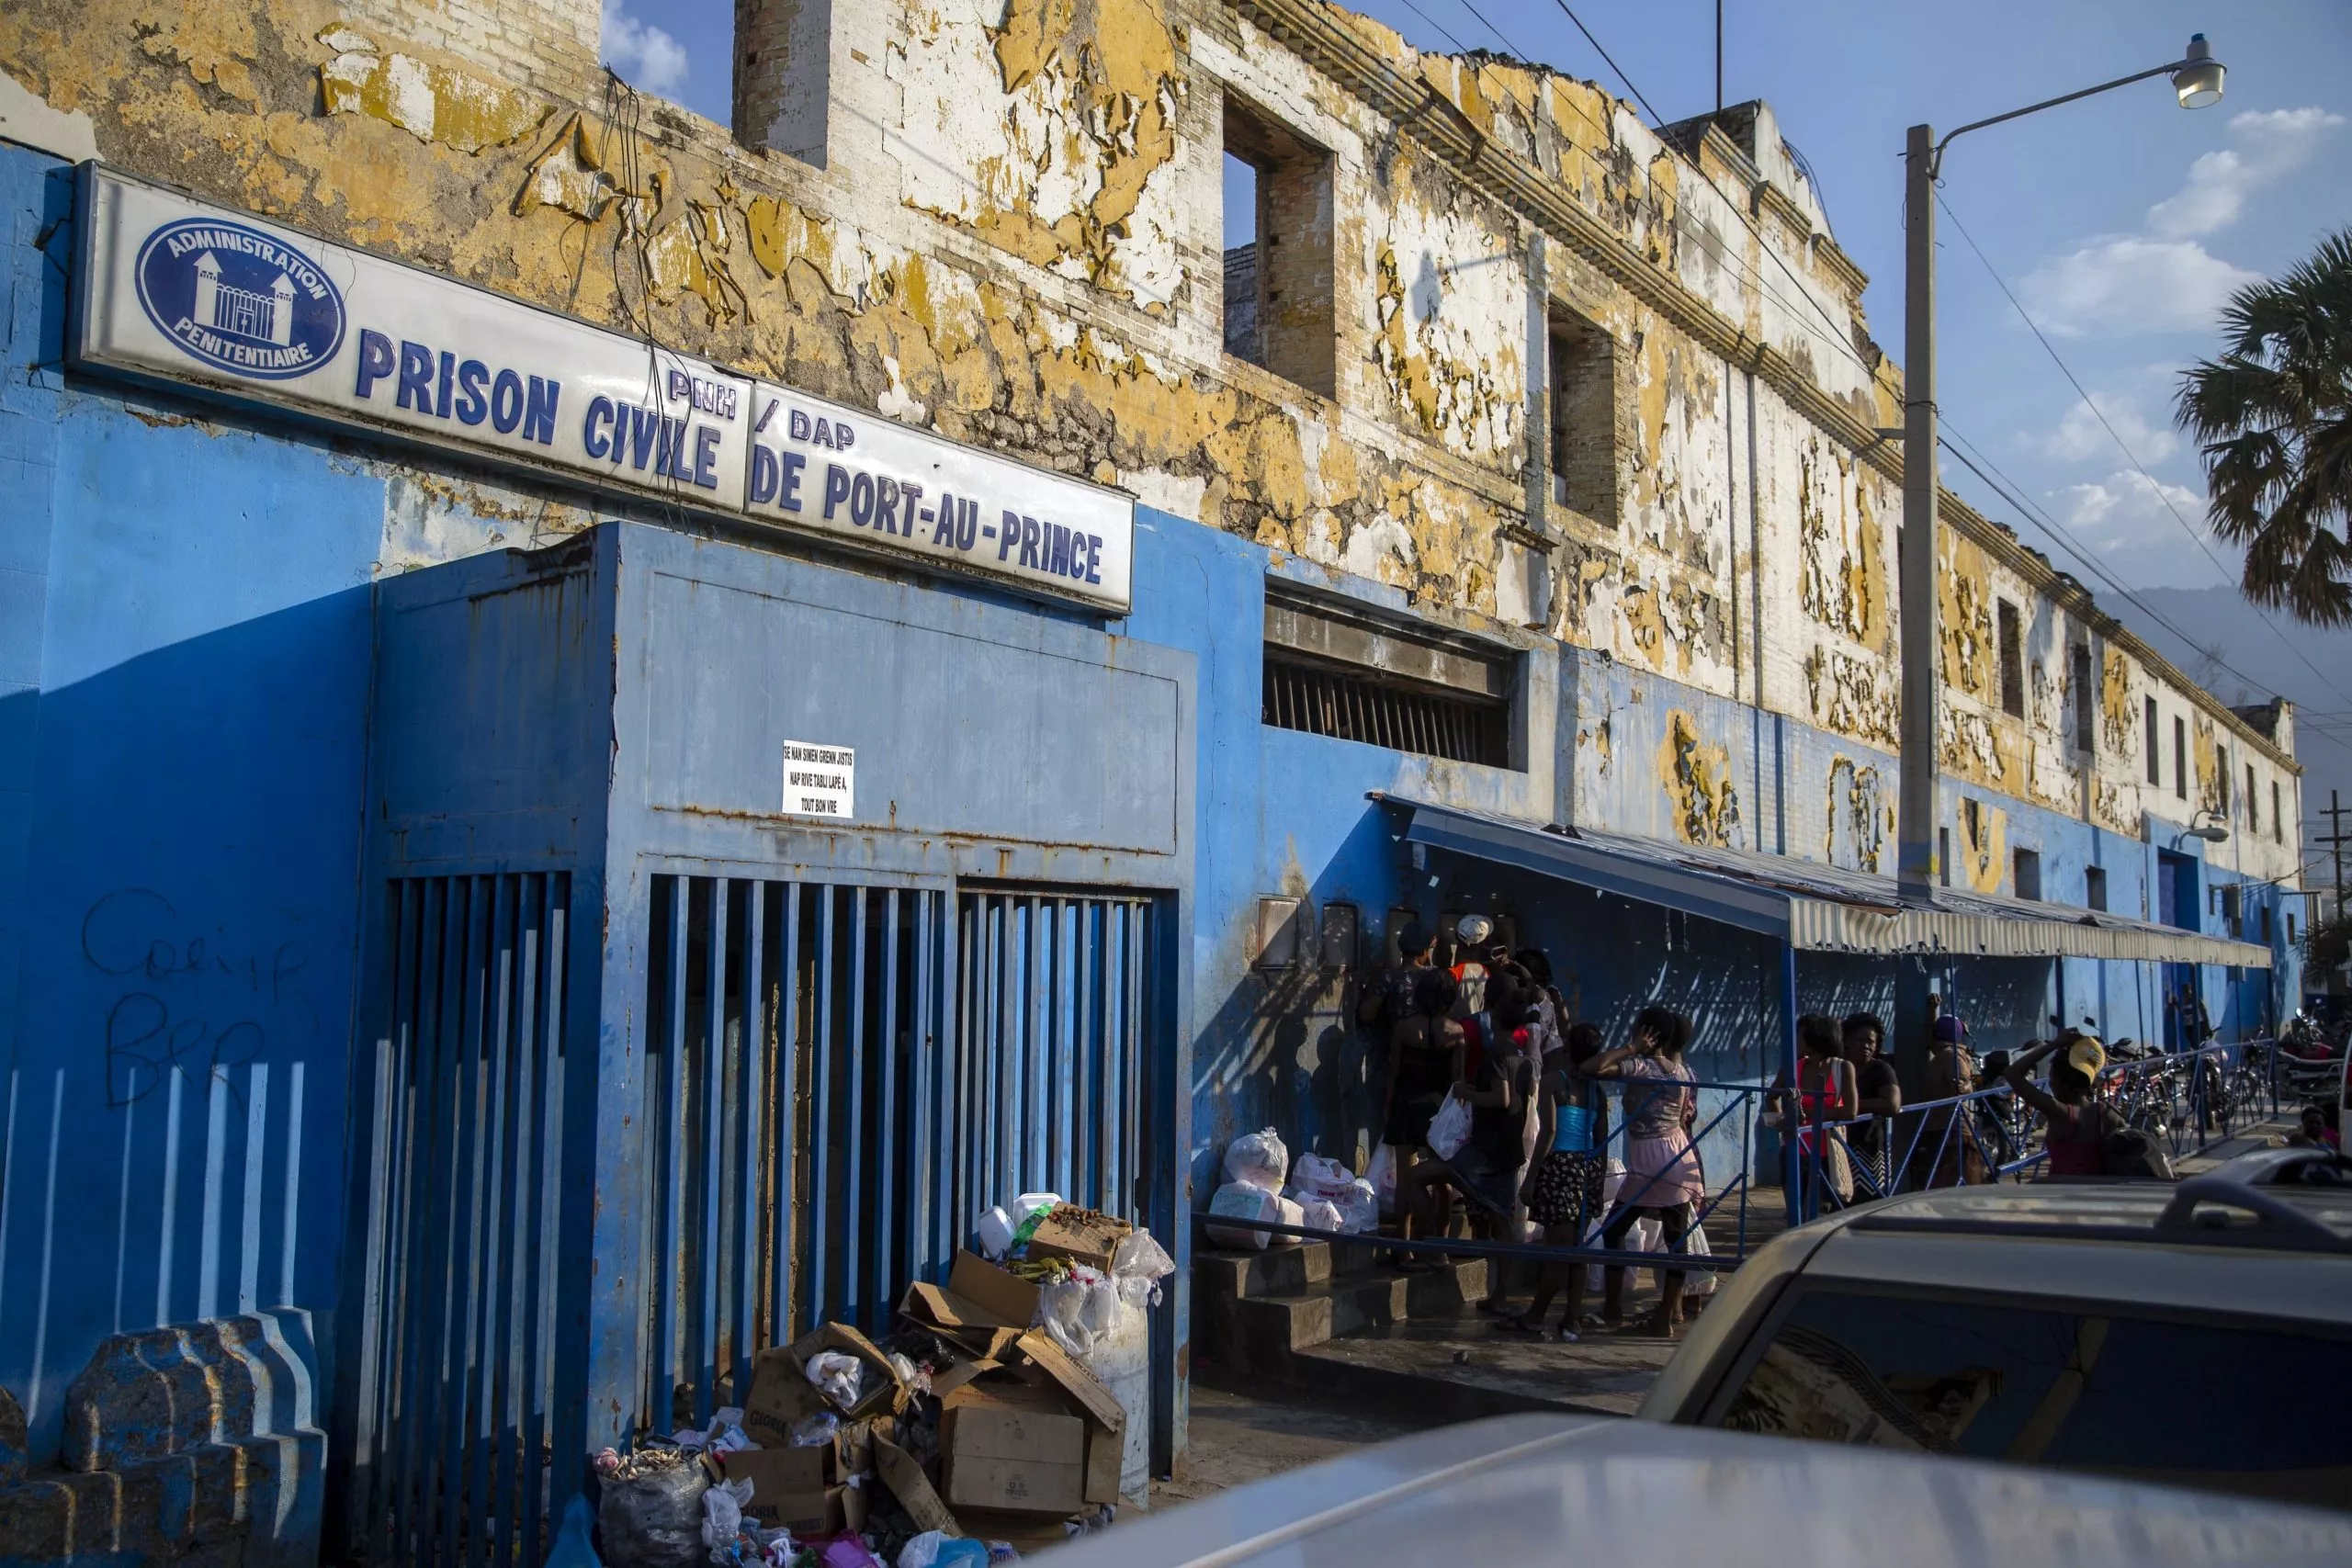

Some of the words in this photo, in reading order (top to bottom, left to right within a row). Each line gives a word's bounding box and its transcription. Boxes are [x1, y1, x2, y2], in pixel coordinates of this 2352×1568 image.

[168, 230, 328, 301] ADMINISTRATION
[173, 316, 313, 367] PENITENTIAIRE
[670, 370, 736, 420] PNH
[791, 410, 854, 451] DAP
[355, 328, 560, 446] PRISON
[583, 393, 721, 490] CIVILE
[751, 444, 807, 512] DE
[824, 463, 1102, 584] PORT-AU-PRINCE
[791, 747, 802, 761] NAN
[790, 772, 800, 785] NAP
[801, 773, 813, 786] RIVE
[814, 774, 828, 788] TABLI
[801, 797, 814, 812] TOUT
[815, 799, 826, 813] BON
[749, 1410, 787, 1440] GLORIA
